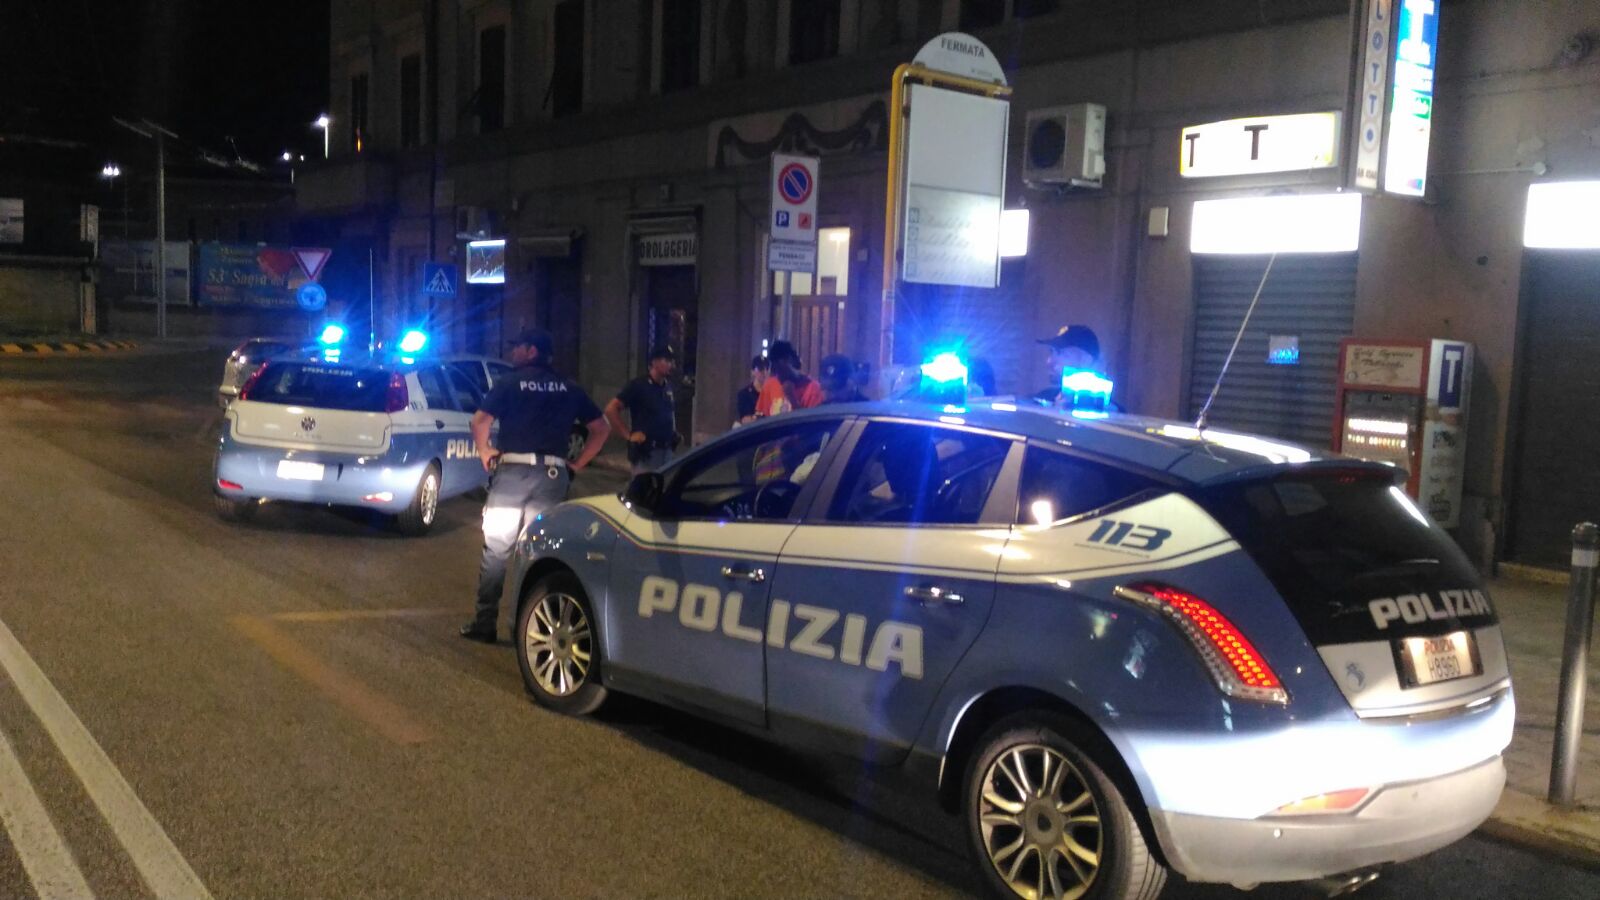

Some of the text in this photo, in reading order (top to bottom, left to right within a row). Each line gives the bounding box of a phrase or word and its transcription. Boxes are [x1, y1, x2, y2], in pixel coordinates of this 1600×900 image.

[941, 37, 985, 58] FERMATA
[1366, 0, 1385, 143] LOTTO
[640, 239, 698, 258] OROLOGERIA
[519, 380, 568, 392] POLIZIA
[1445, 350, 1461, 393] T
[447, 439, 492, 460] POLI
[1087, 519, 1172, 552] 113
[1368, 589, 1492, 630] POLIZIA
[637, 575, 924, 680] POLIZIA
